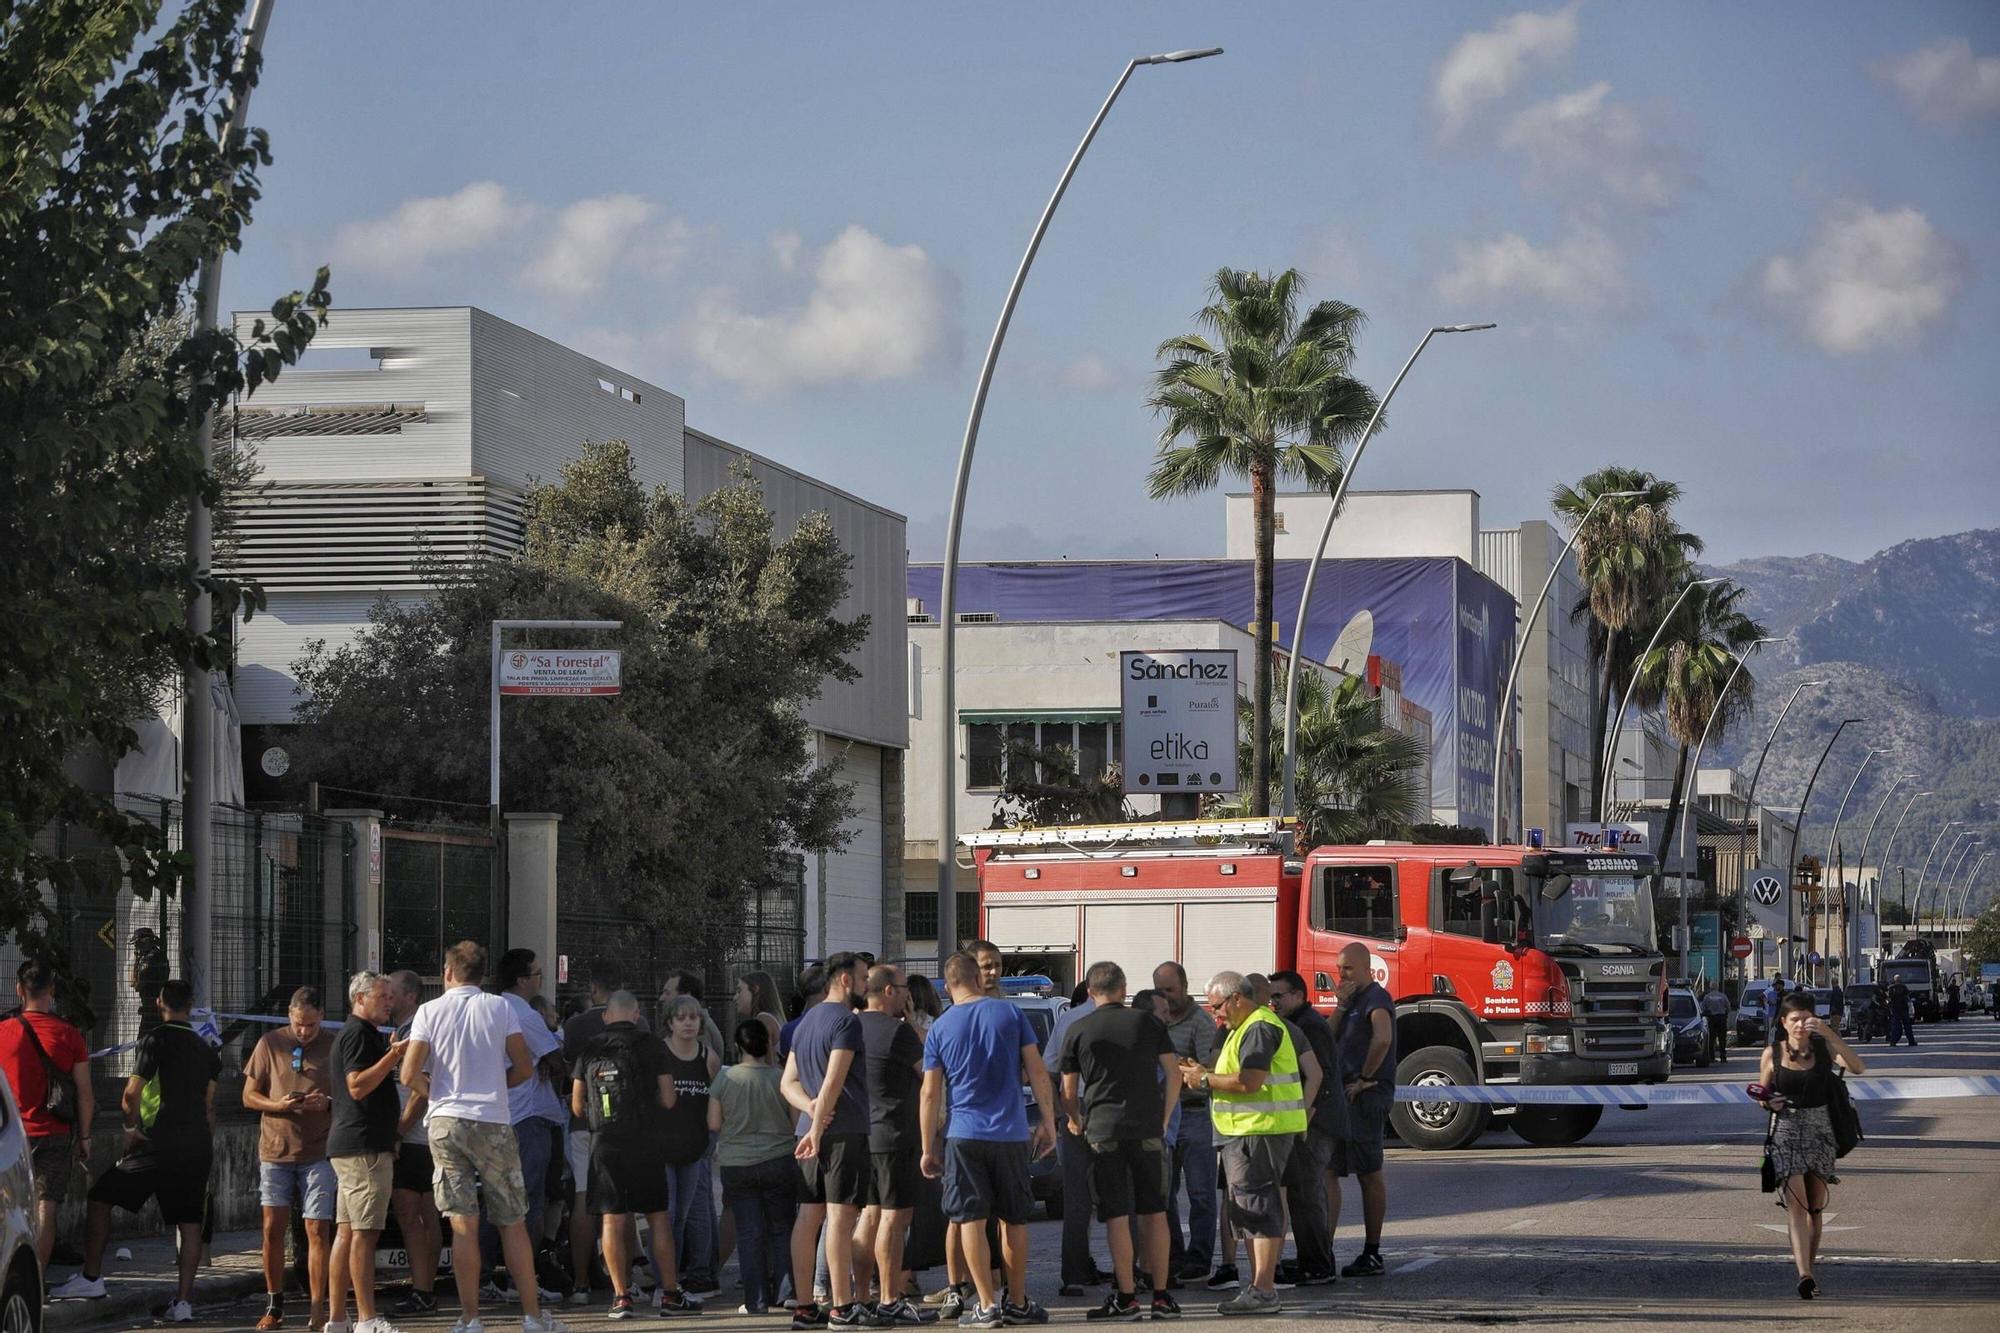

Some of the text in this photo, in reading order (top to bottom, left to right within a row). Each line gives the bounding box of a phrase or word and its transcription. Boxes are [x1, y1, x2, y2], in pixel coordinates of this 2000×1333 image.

[1130, 658, 1228, 680] Sánchez
[1189, 699, 1220, 709] Puratos
[1150, 733, 1208, 760] etika
[1574, 830, 1642, 845] Mata
[1601, 965, 1635, 976] SCANIA
[1484, 1006, 1520, 1014] de Palma
